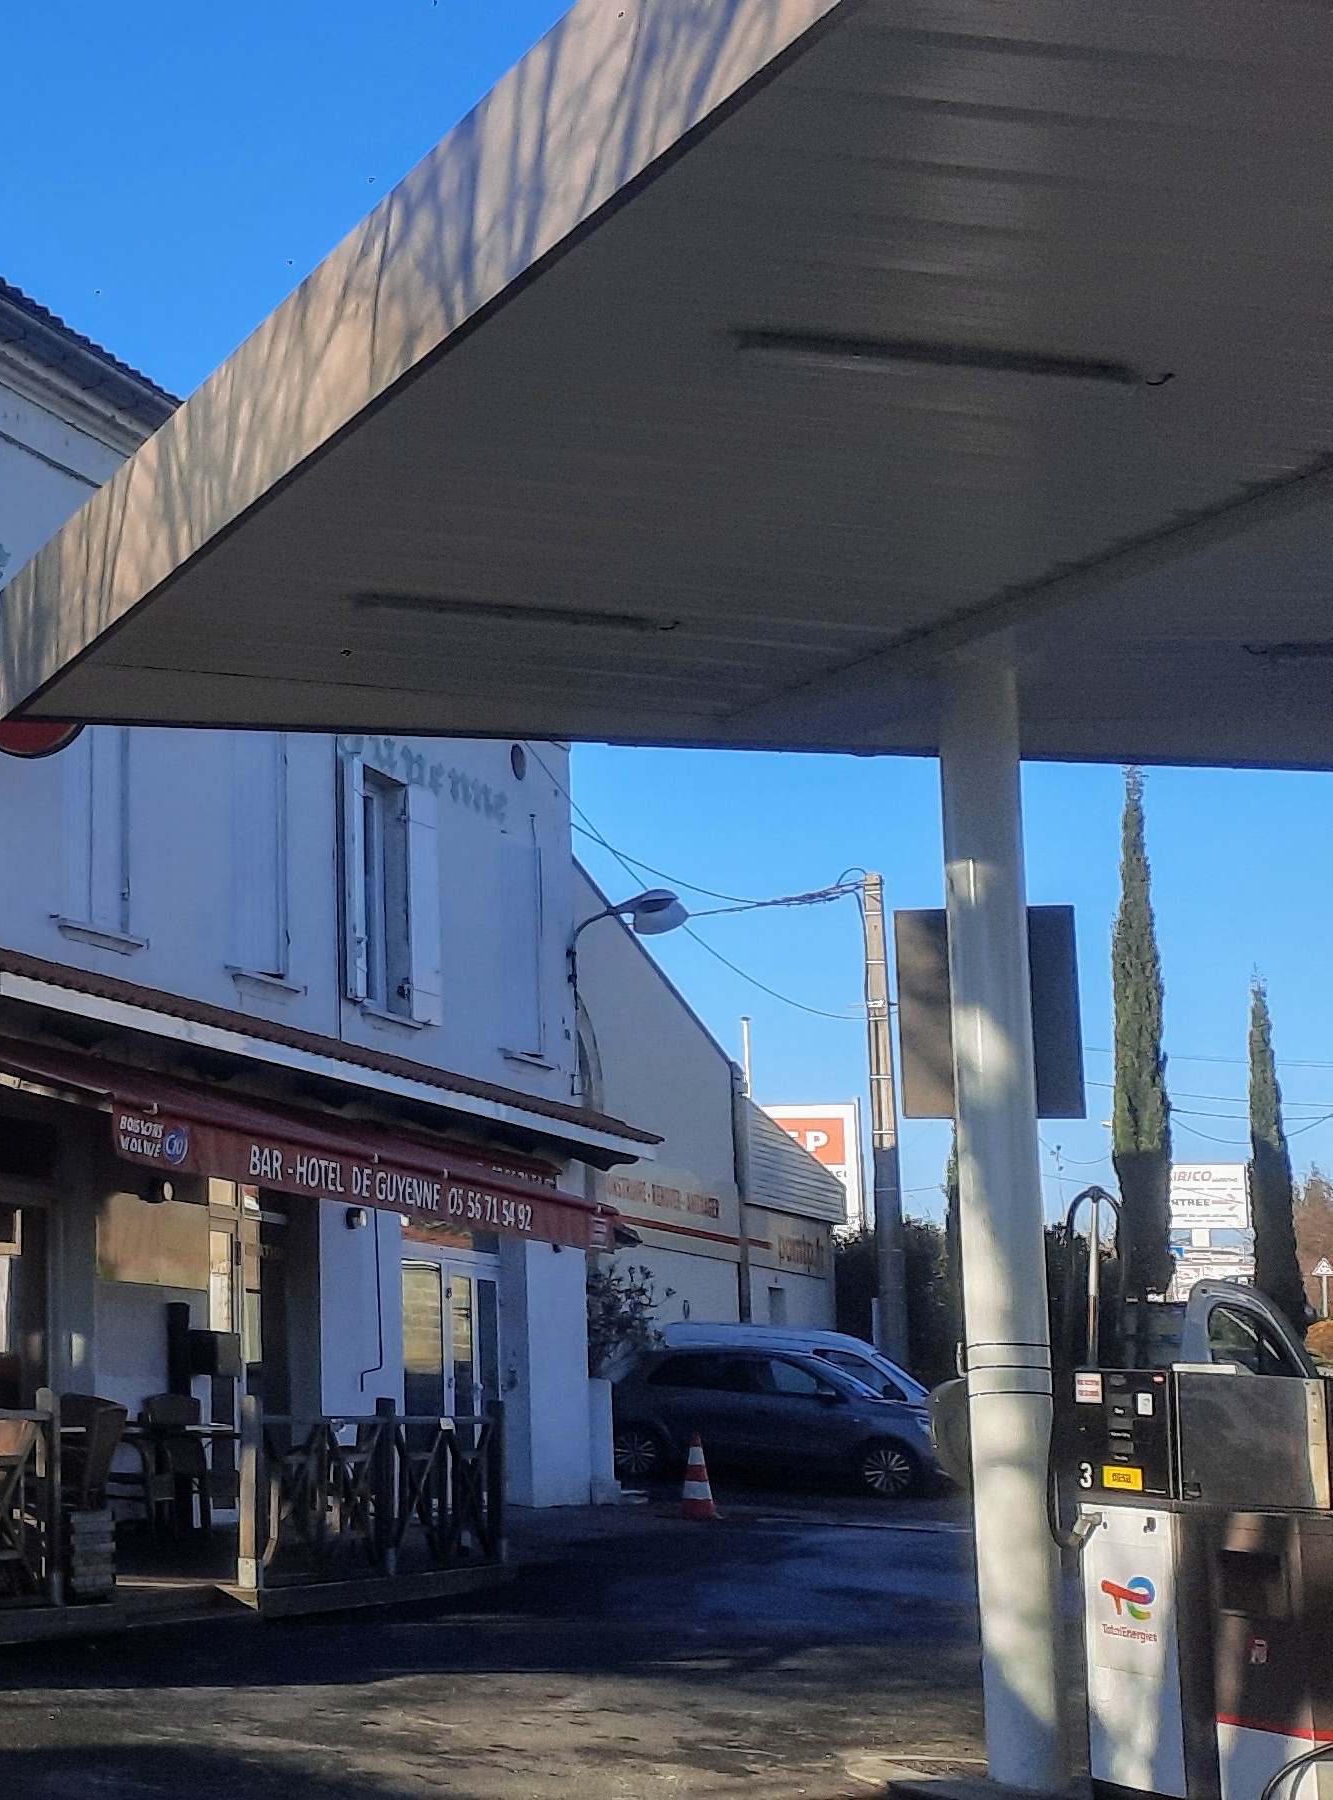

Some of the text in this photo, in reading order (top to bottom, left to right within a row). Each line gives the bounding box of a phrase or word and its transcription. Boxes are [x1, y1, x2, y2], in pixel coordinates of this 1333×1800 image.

[249, 1144, 282, 1181] BAR
[295, 1154, 345, 1193] HOTEL
[351, 1166, 372, 1198] DE
[376, 1171, 441, 1211] GUYENNE
[448, 1187, 463, 1215] 05
[467, 1191, 482, 1219] 56
[485, 1195, 499, 1223] 71
[502, 1200, 516, 1227] 54
[518, 1204, 533, 1231] 92
[1079, 1462, 1093, 1488] 3
